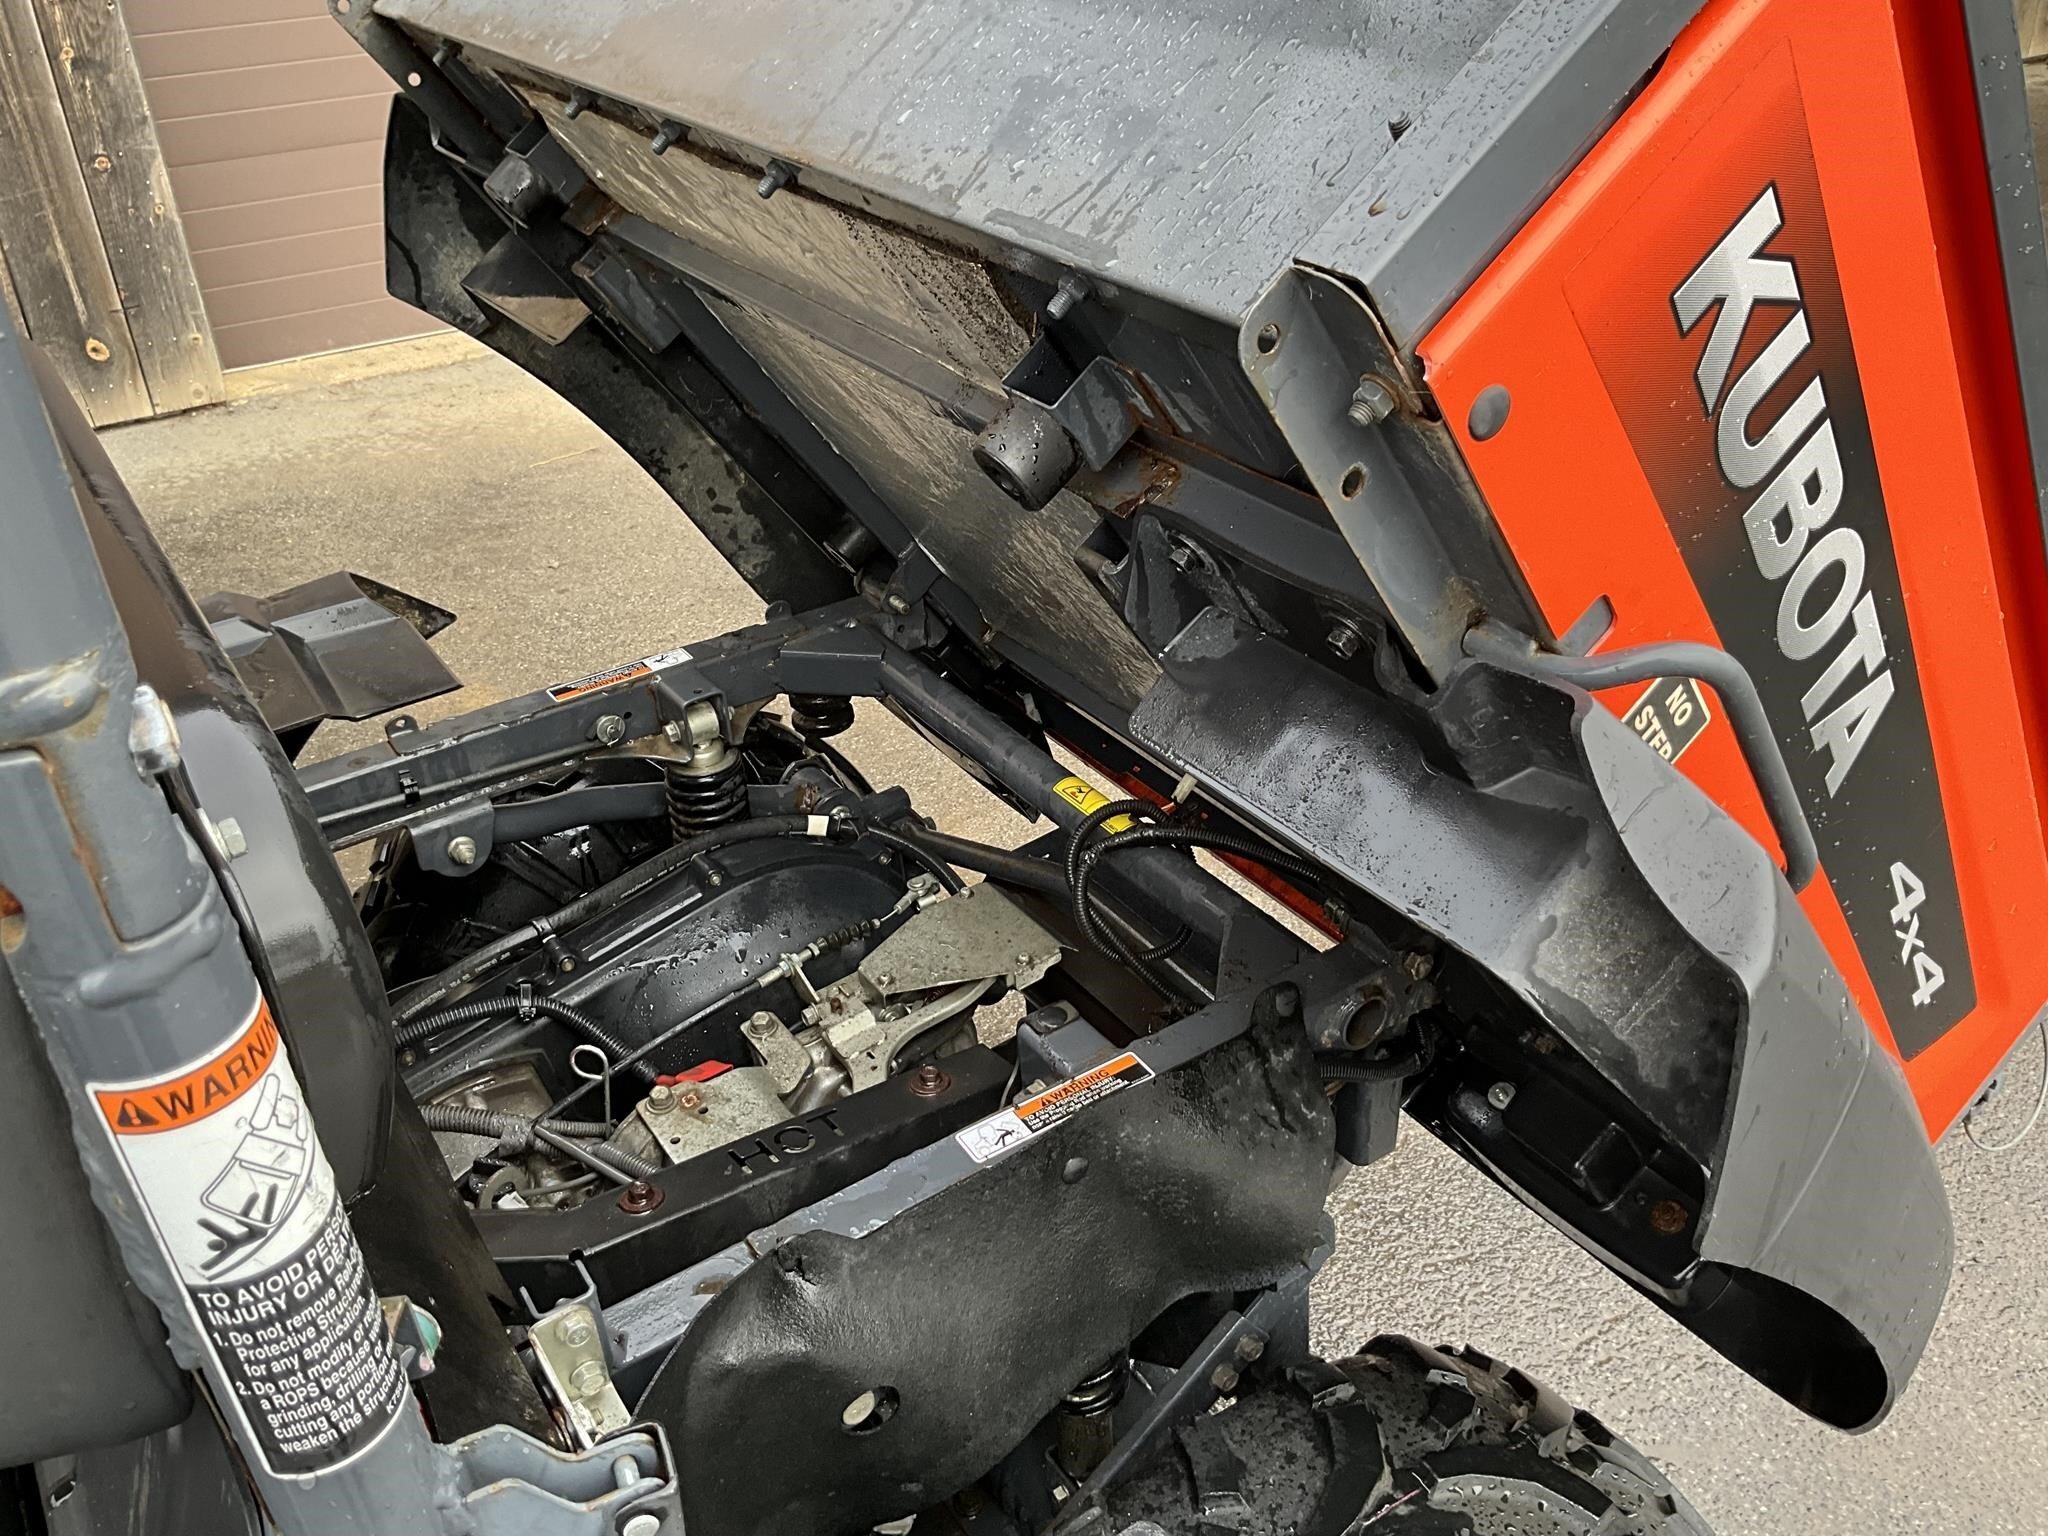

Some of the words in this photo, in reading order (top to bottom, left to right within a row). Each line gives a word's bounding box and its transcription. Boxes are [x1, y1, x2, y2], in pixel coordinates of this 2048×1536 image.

[1674, 185, 1894, 798] KUBOTA
[1635, 705, 1672, 760] STEP
[1665, 684, 1692, 726] NO
[1890, 860, 1945, 1006] 4x4
[1033, 1103, 1057, 1117] AVOID
[1050, 1068, 1110, 1100] WARNING
[728, 1108, 844, 1175] HOT
[198, 1292, 231, 1308] TO
[238, 1262, 304, 1305] AVOID
[208, 1292, 287, 1326] INJURY
[293, 1270, 323, 1299] OR
[213, 1332, 229, 1347] 1.
[229, 1331, 254, 1347] Do
[256, 1321, 285, 1343] not
[286, 1287, 336, 1332] remove
[236, 1326, 317, 1362] Protective
[243, 1362, 267, 1377] for
[271, 1353, 299, 1373] any
[303, 1295, 366, 1360] application.
[236, 1381, 252, 1396] 2.
[251, 1380, 276, 1396] Do
[278, 1371, 306, 1391] not
[307, 1338, 354, 1380] modify
[353, 1323, 365, 1344] or
[260, 1399, 271, 1410] a
[272, 1382, 320, 1409] ROPS
[321, 1339, 371, 1391] because
[267, 1395, 336, 1428] grinding,
[336, 1355, 378, 1400] drilling
[374, 1338, 383, 1359] or
[273, 1415, 329, 1440] cutting
[329, 1397, 355, 1422] any
[356, 1354, 389, 1407] portion
[279, 1428, 339, 1454] weaken
[339, 1412, 363, 1435] the
